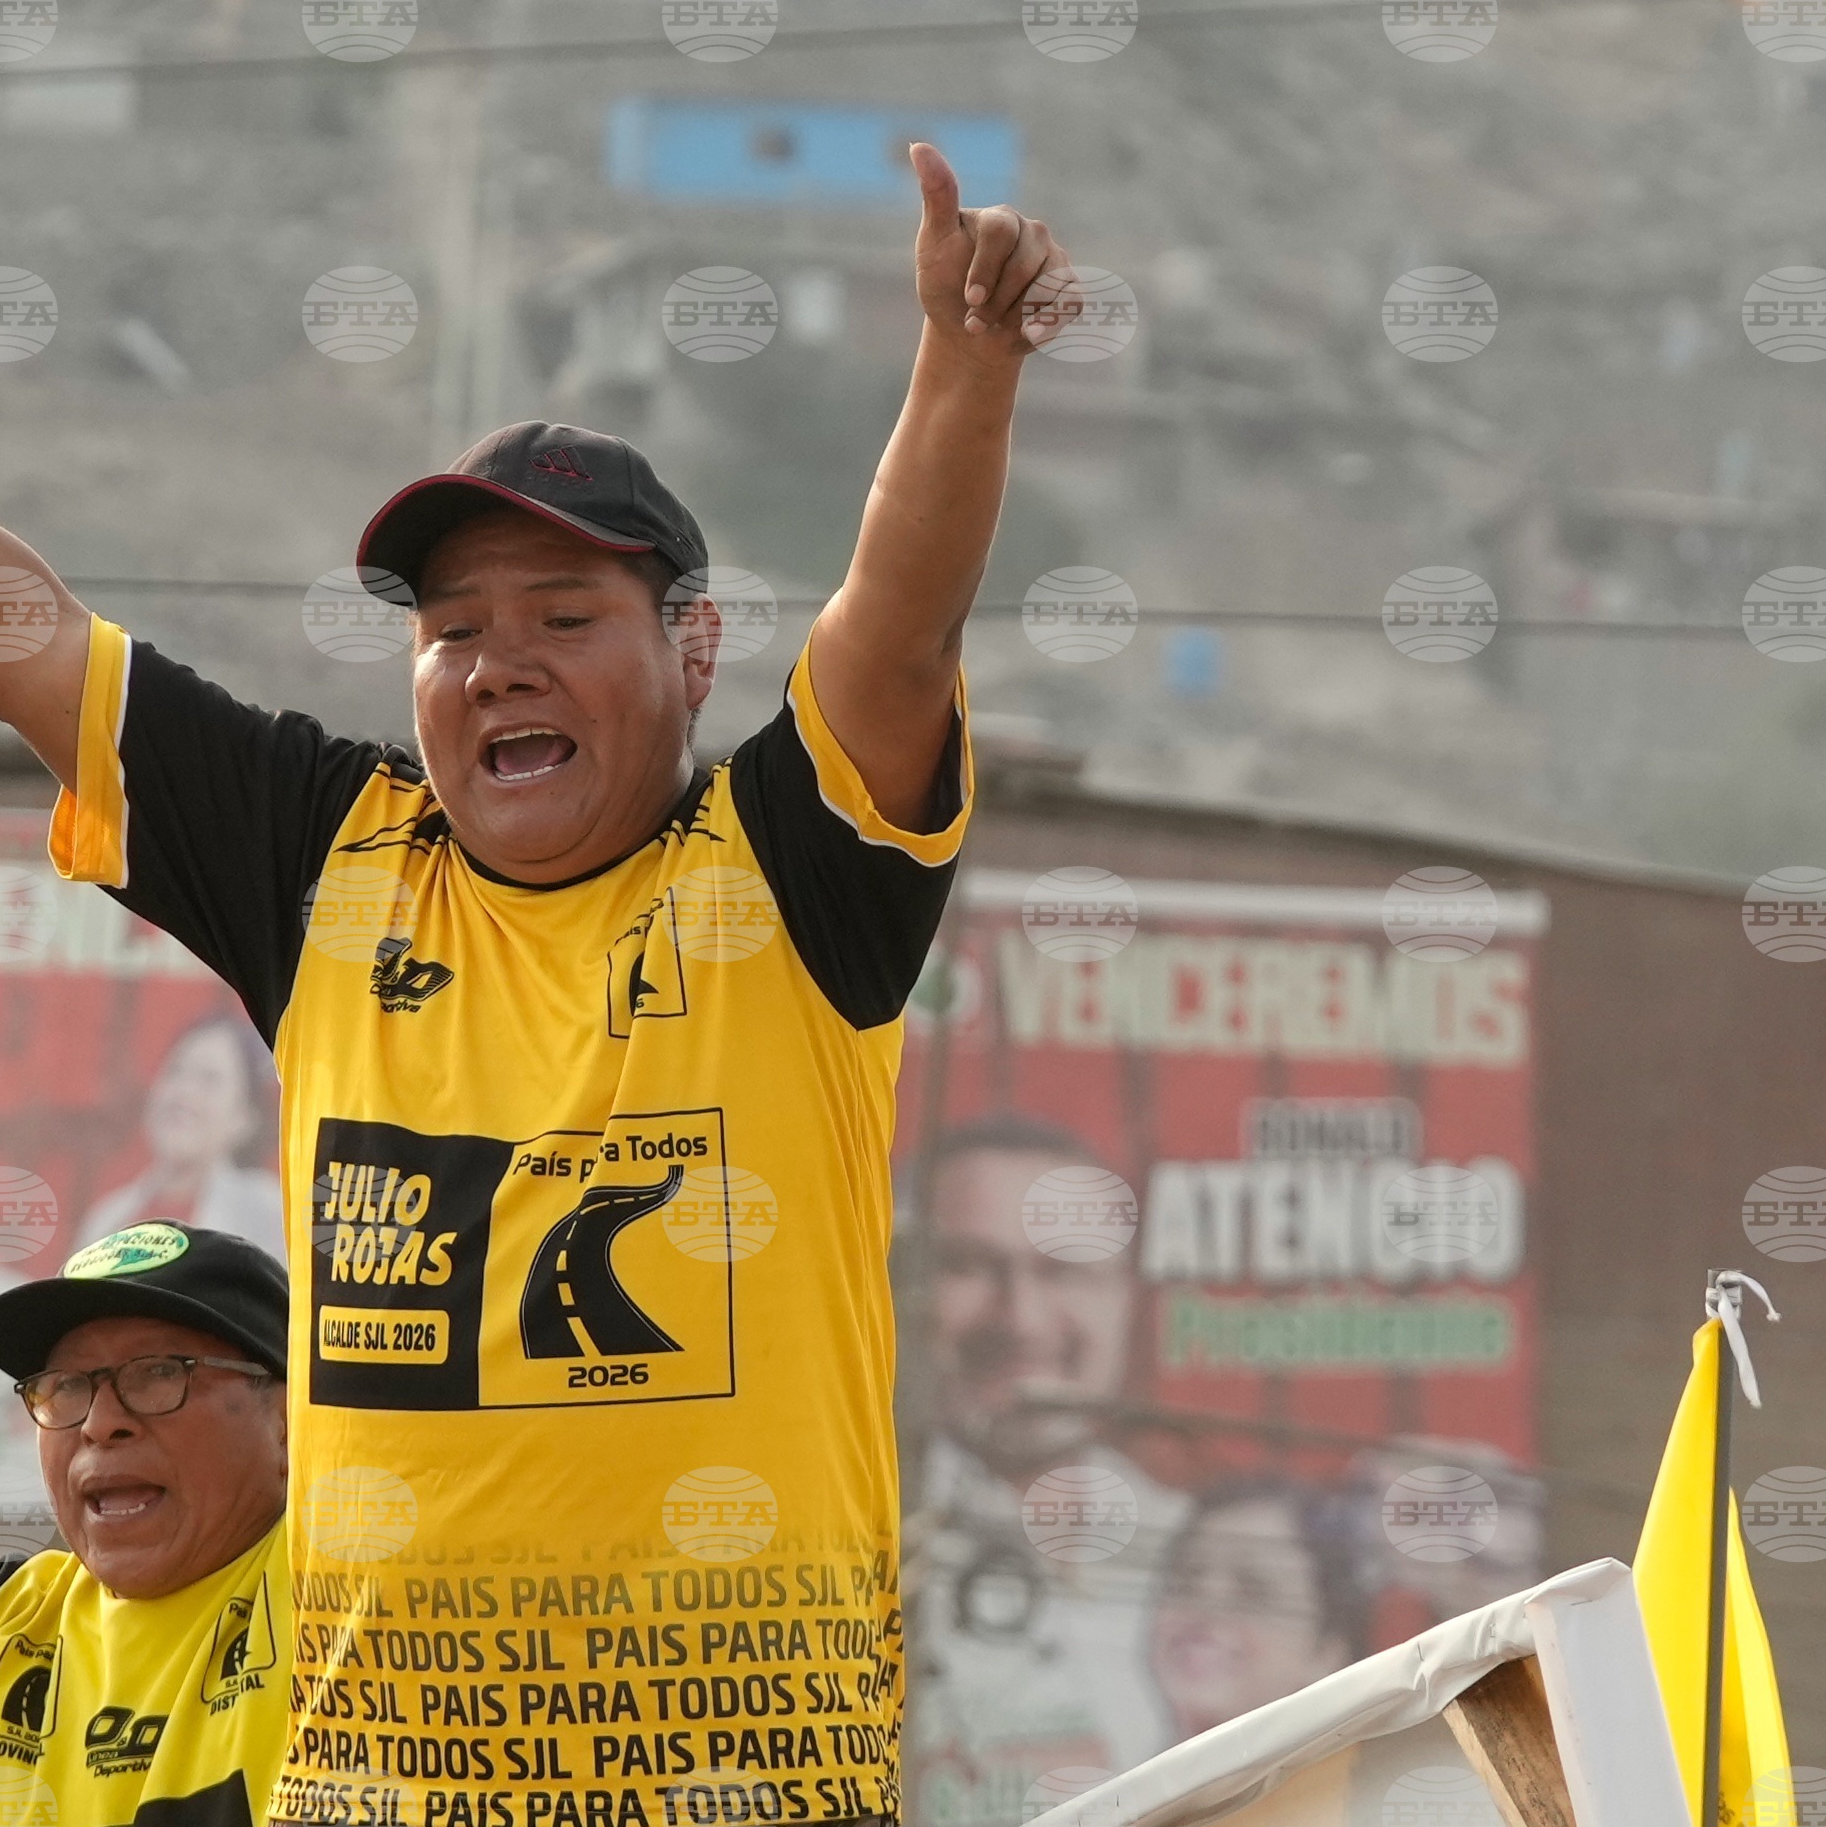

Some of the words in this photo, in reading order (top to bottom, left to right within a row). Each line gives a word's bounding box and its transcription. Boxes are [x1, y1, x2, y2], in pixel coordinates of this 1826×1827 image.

[513, 1150, 572, 1178] País
[626, 1132, 708, 1161] Todos
[325, 1161, 431, 1227] JULIO
[331, 1224, 457, 1287] ROJAS
[323, 1318, 361, 1351] ALCALDE
[364, 1324, 388, 1351] SJL
[392, 1322, 436, 1351] 2026
[567, 1363, 650, 1389] 2026
[404, 1575, 499, 1619] PAIS
[510, 1572, 635, 1619] PARA
[641, 1564, 788, 1613] TODOS
[795, 1563, 845, 1607] SJL
[363, 1628, 485, 1673] TODOS
[494, 1628, 566, 1672] SJL
[585, 1623, 688, 1670] PAIS
[700, 1619, 813, 1665] PARA
[358, 1678, 408, 1725] SJL
[420, 1683, 507, 1727] PAIS
[519, 1680, 641, 1726] PARA
[647, 1672, 796, 1721] TODOS
[804, 1671, 853, 1714] SJL
[302, 1727, 371, 1775] PARA
[375, 1734, 495, 1780] TODOS
[502, 1737, 573, 1781] SJL
[592, 1730, 696, 1779] PAIS
[706, 1725, 824, 1773] PARA
[654, 1779, 810, 1827] TODOS
[815, 1776, 874, 1819] SJL
